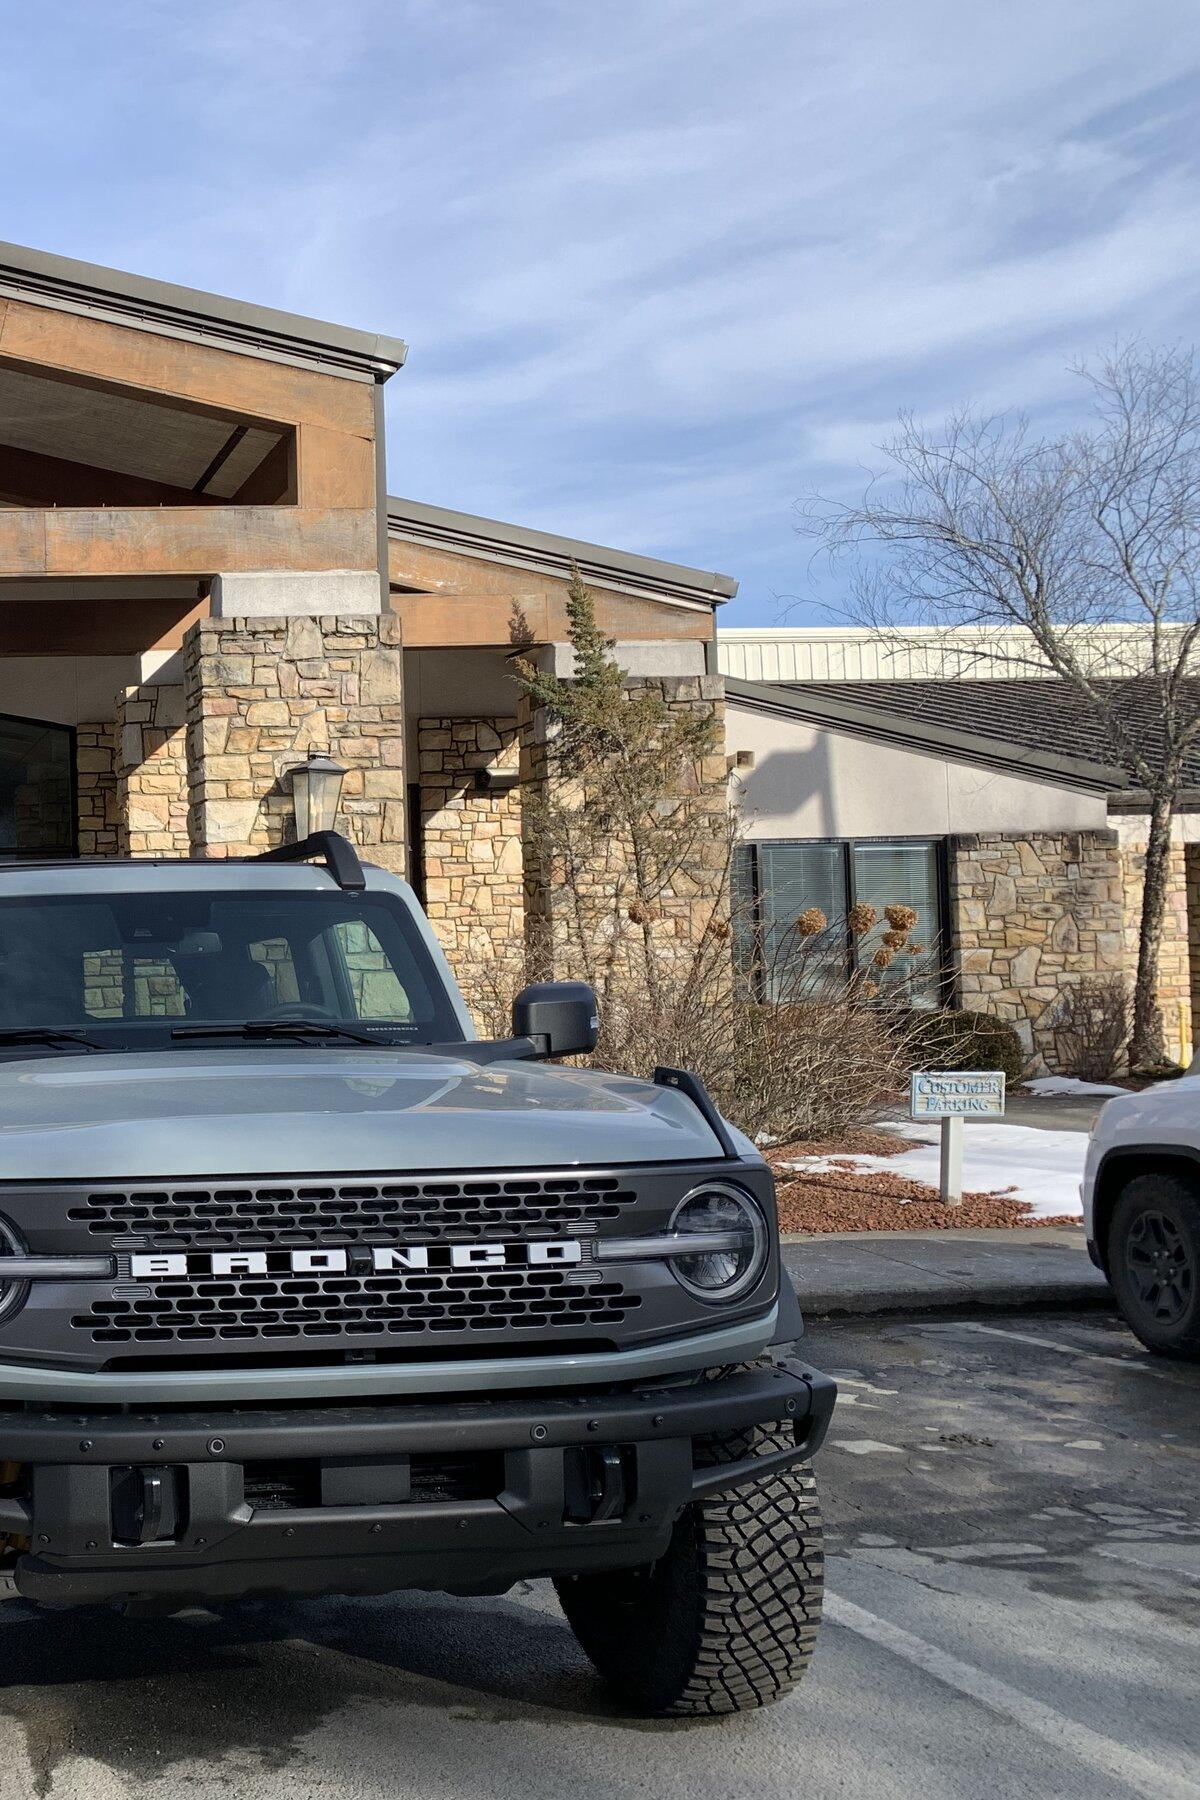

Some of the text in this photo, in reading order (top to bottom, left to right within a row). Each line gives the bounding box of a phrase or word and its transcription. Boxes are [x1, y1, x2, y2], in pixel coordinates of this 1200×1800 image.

[918, 1079, 1000, 1095] CUSTOMER
[925, 1096, 989, 1112] PARKING
[131, 1240, 582, 1278] BRONCO
